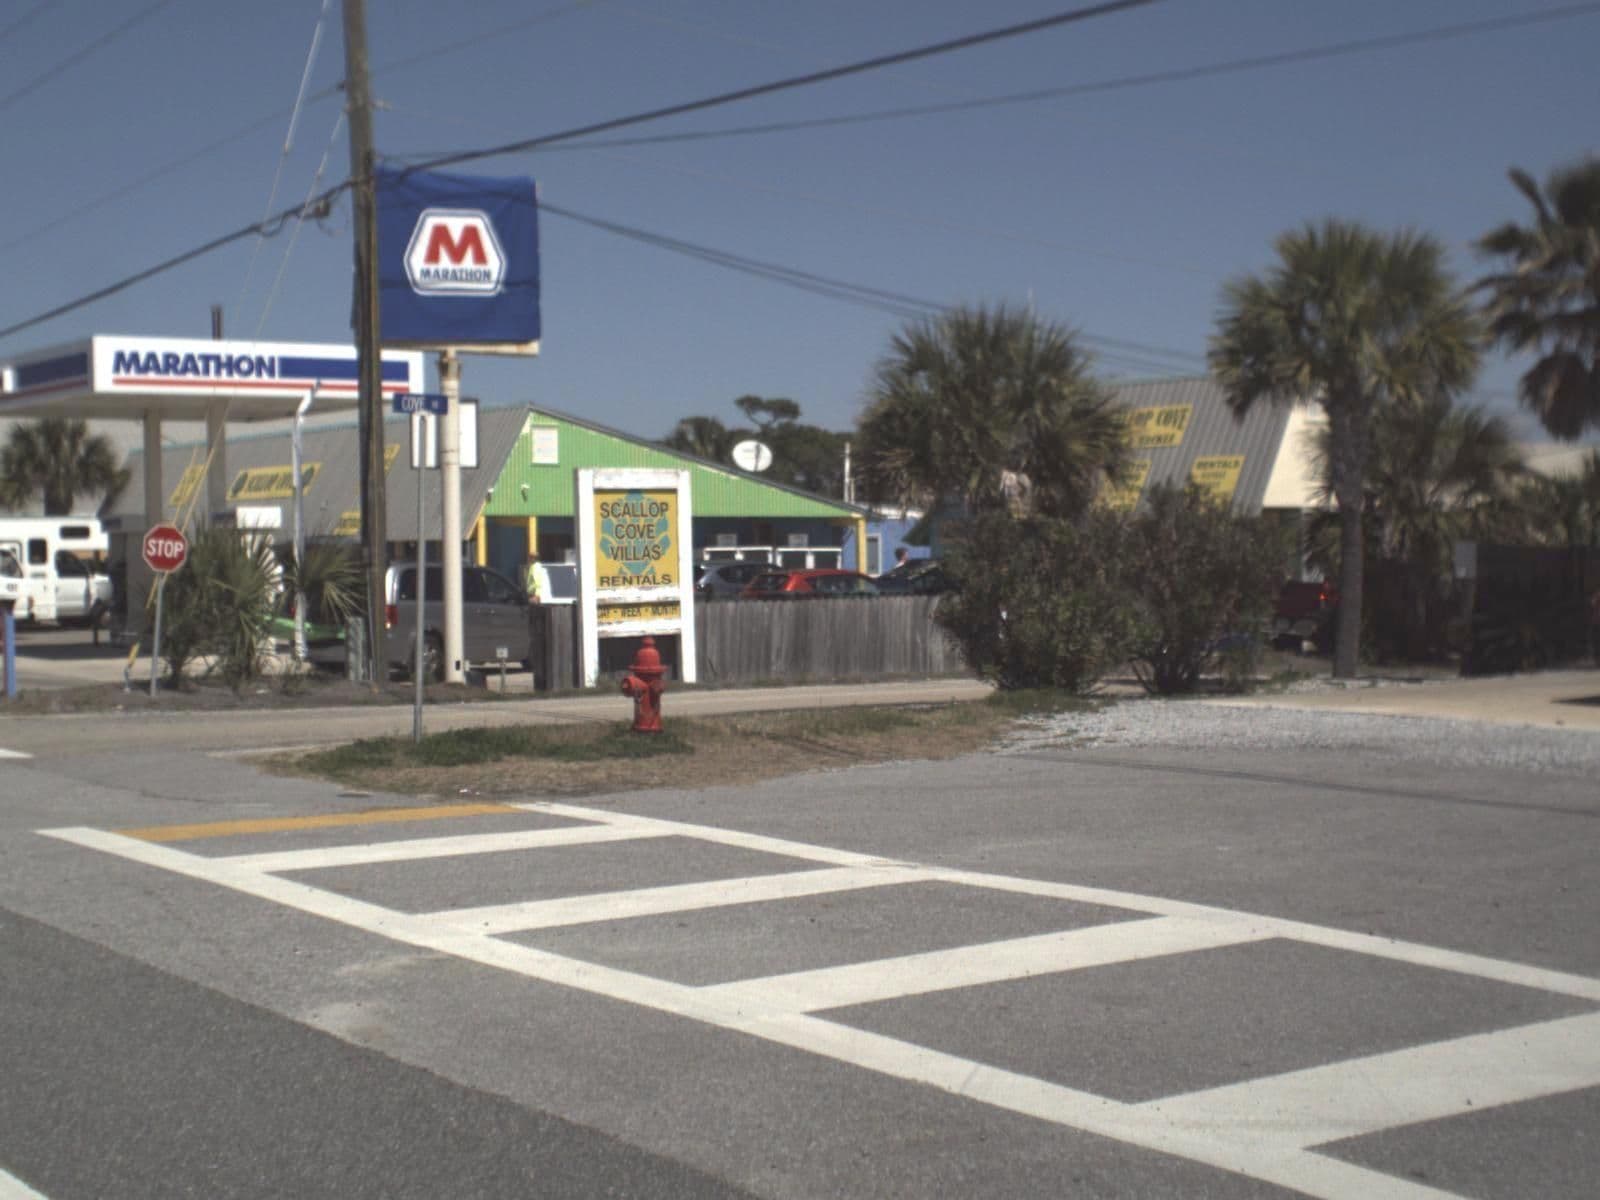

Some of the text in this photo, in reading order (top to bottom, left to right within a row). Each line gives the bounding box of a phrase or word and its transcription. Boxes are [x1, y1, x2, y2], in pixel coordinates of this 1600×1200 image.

[423, 223, 488, 265] M
[420, 268, 492, 281] MARATHON
[113, 350, 275, 378] MARATHON
[600, 502, 669, 518] SCALLOP
[615, 524, 655, 539] COVE
[146, 539, 184, 558] STOP
[610, 545, 661, 561] VILLAS
[600, 574, 672, 586] RENTALS
